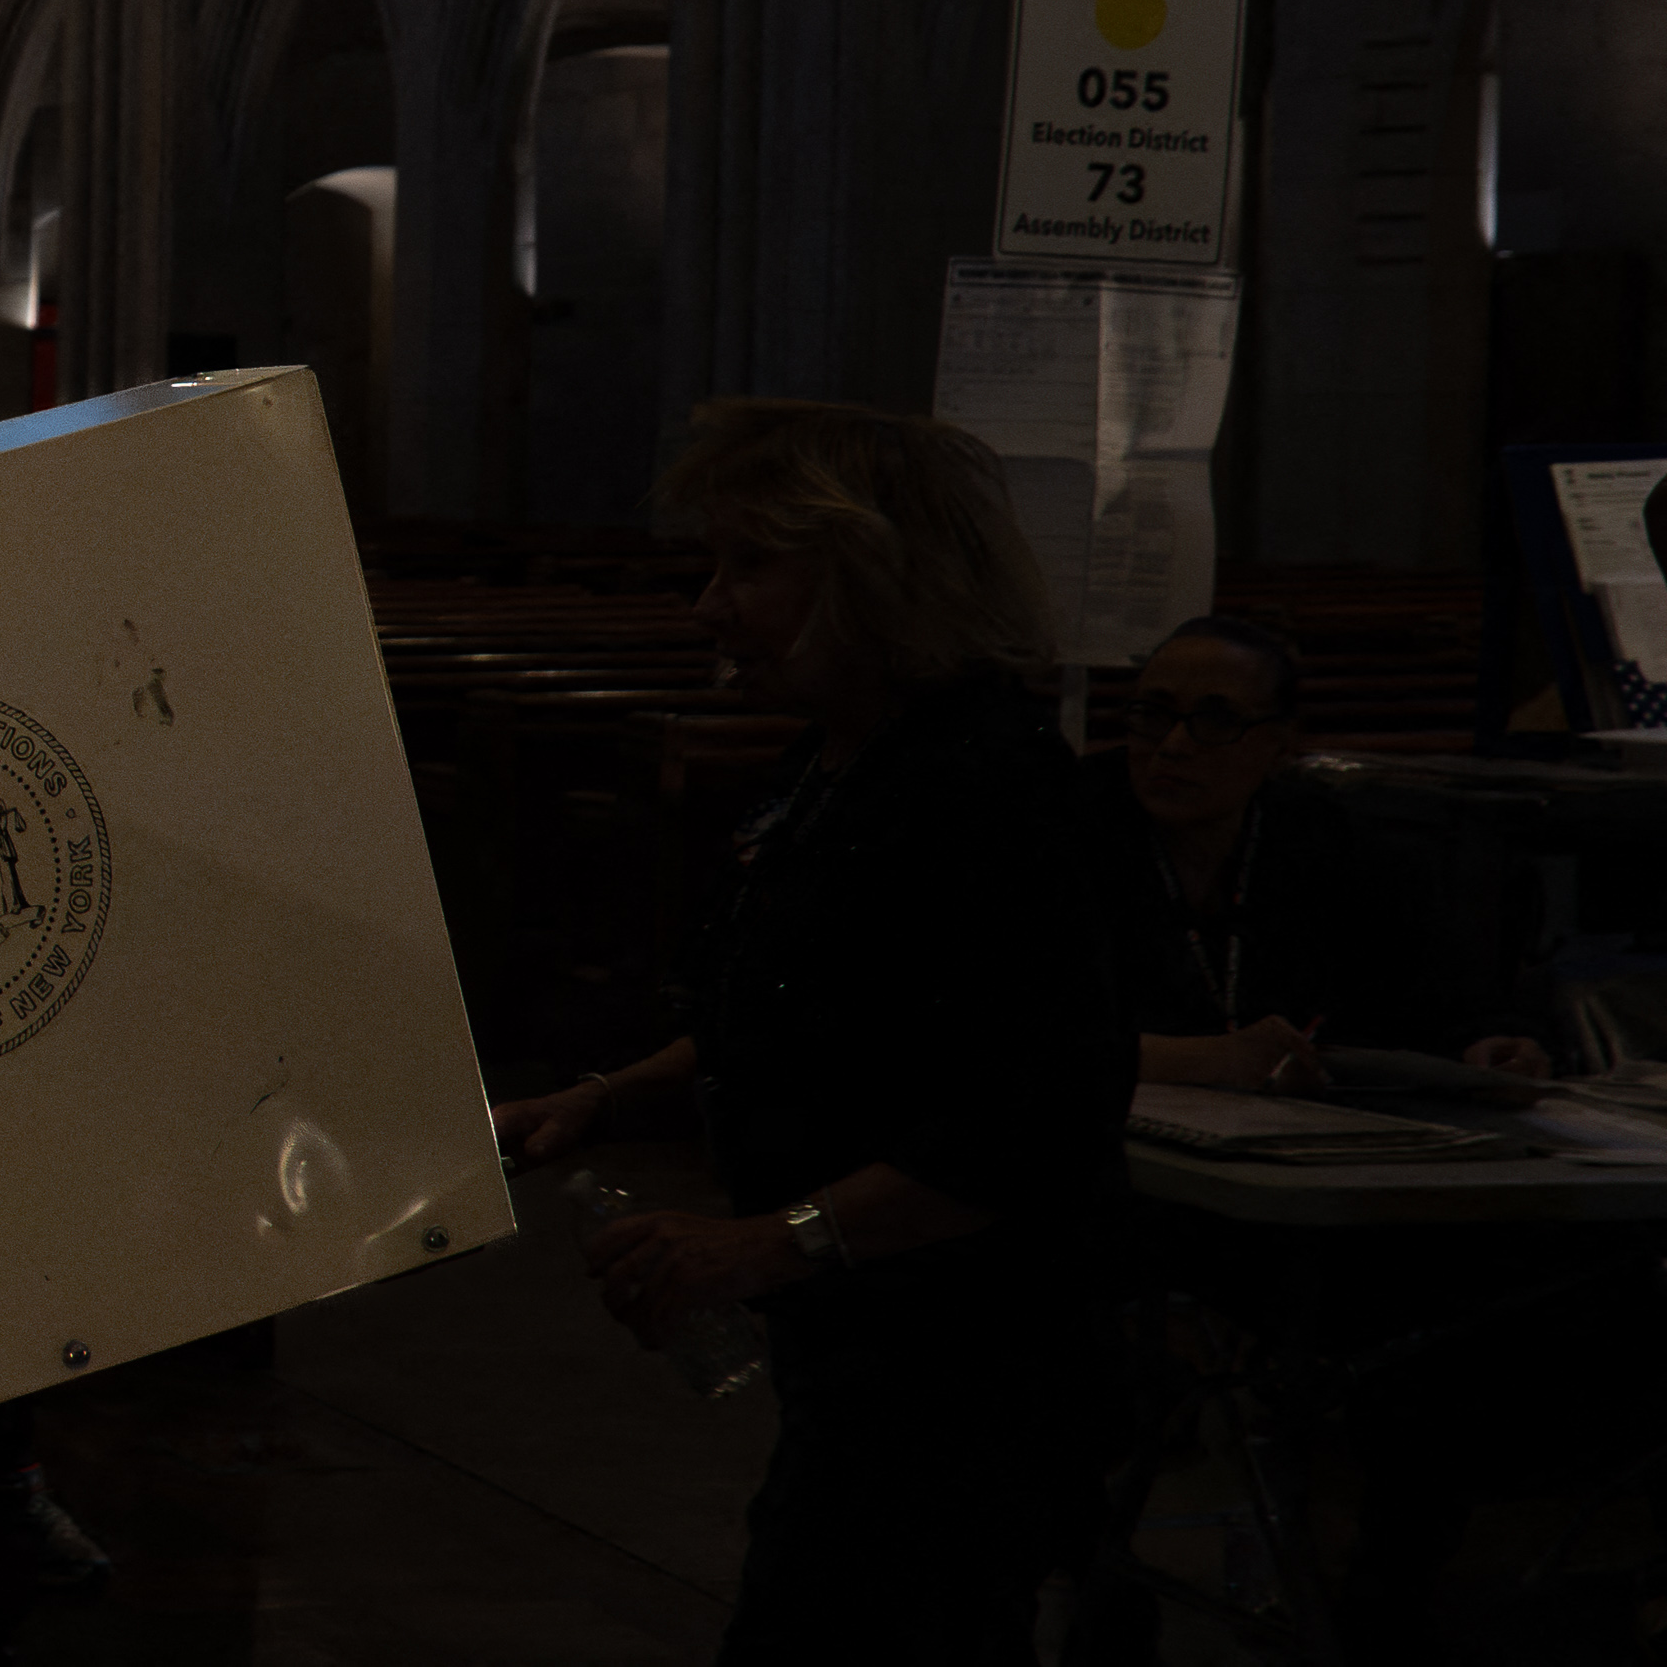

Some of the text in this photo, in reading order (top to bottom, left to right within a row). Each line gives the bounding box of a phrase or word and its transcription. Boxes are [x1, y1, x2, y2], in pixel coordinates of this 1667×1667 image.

[1078, 67, 1169, 111] 055
[1032, 122, 1209, 152] Election District
[1087, 163, 1145, 204] 73
[1013, 212, 1210, 244] Assembly District
[9, 945, 71, 1020] NEW
[61, 836, 94, 935] YORK
